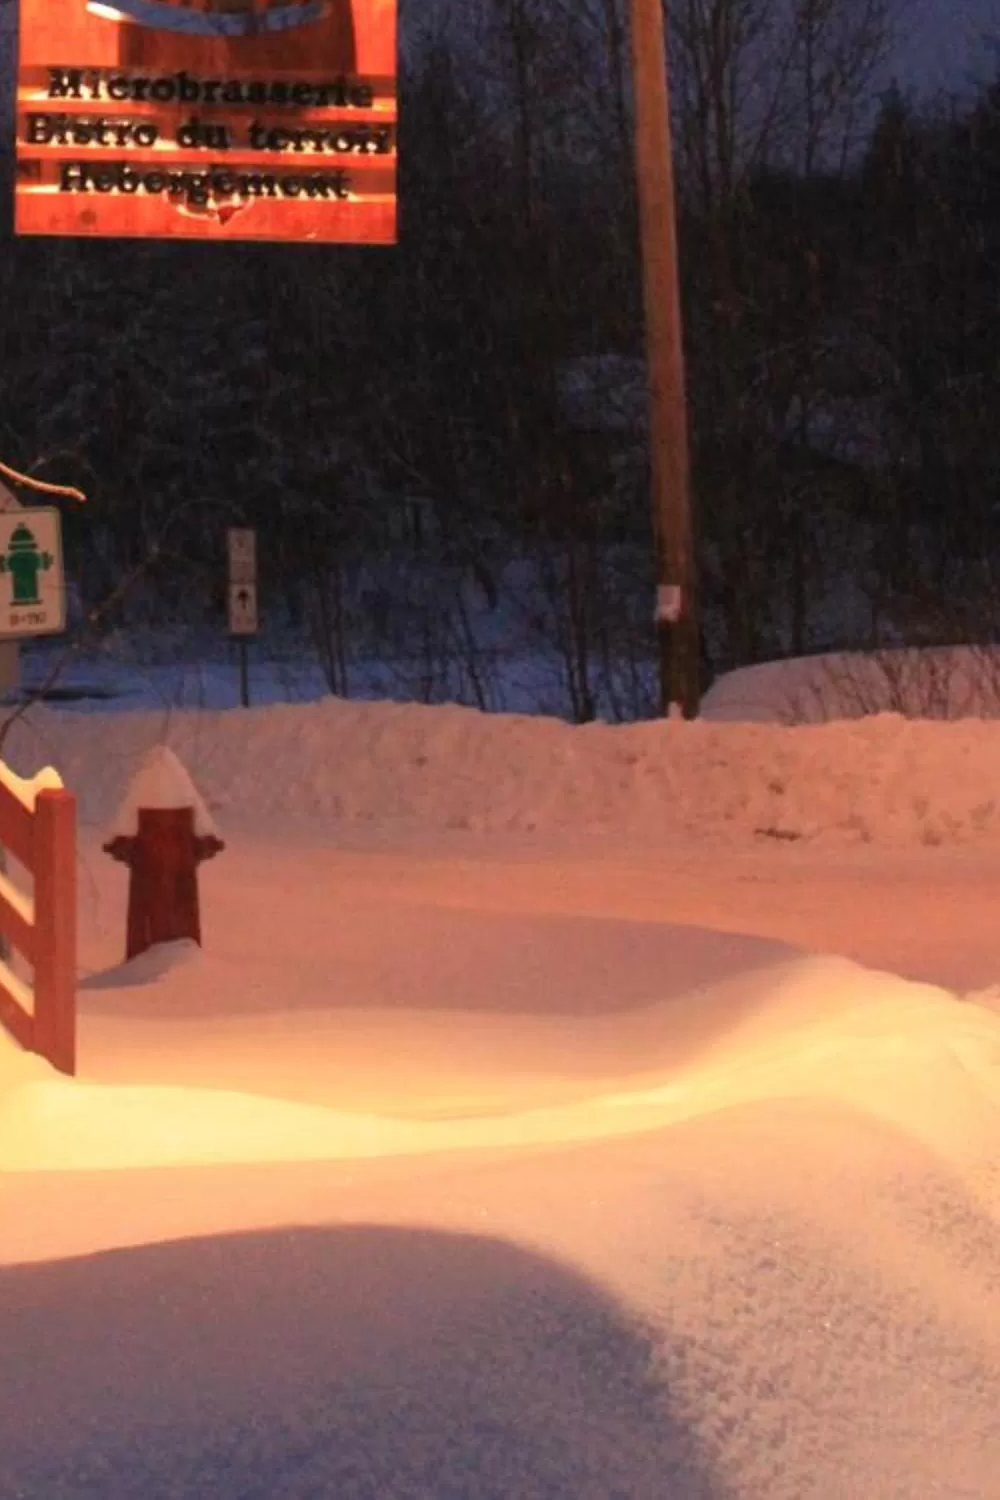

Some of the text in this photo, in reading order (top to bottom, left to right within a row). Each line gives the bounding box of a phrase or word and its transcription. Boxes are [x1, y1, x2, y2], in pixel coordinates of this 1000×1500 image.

[47, 68, 373, 107] Microbrasserie
[25, 113, 157, 147] Bistro
[176, 116, 230, 150] du
